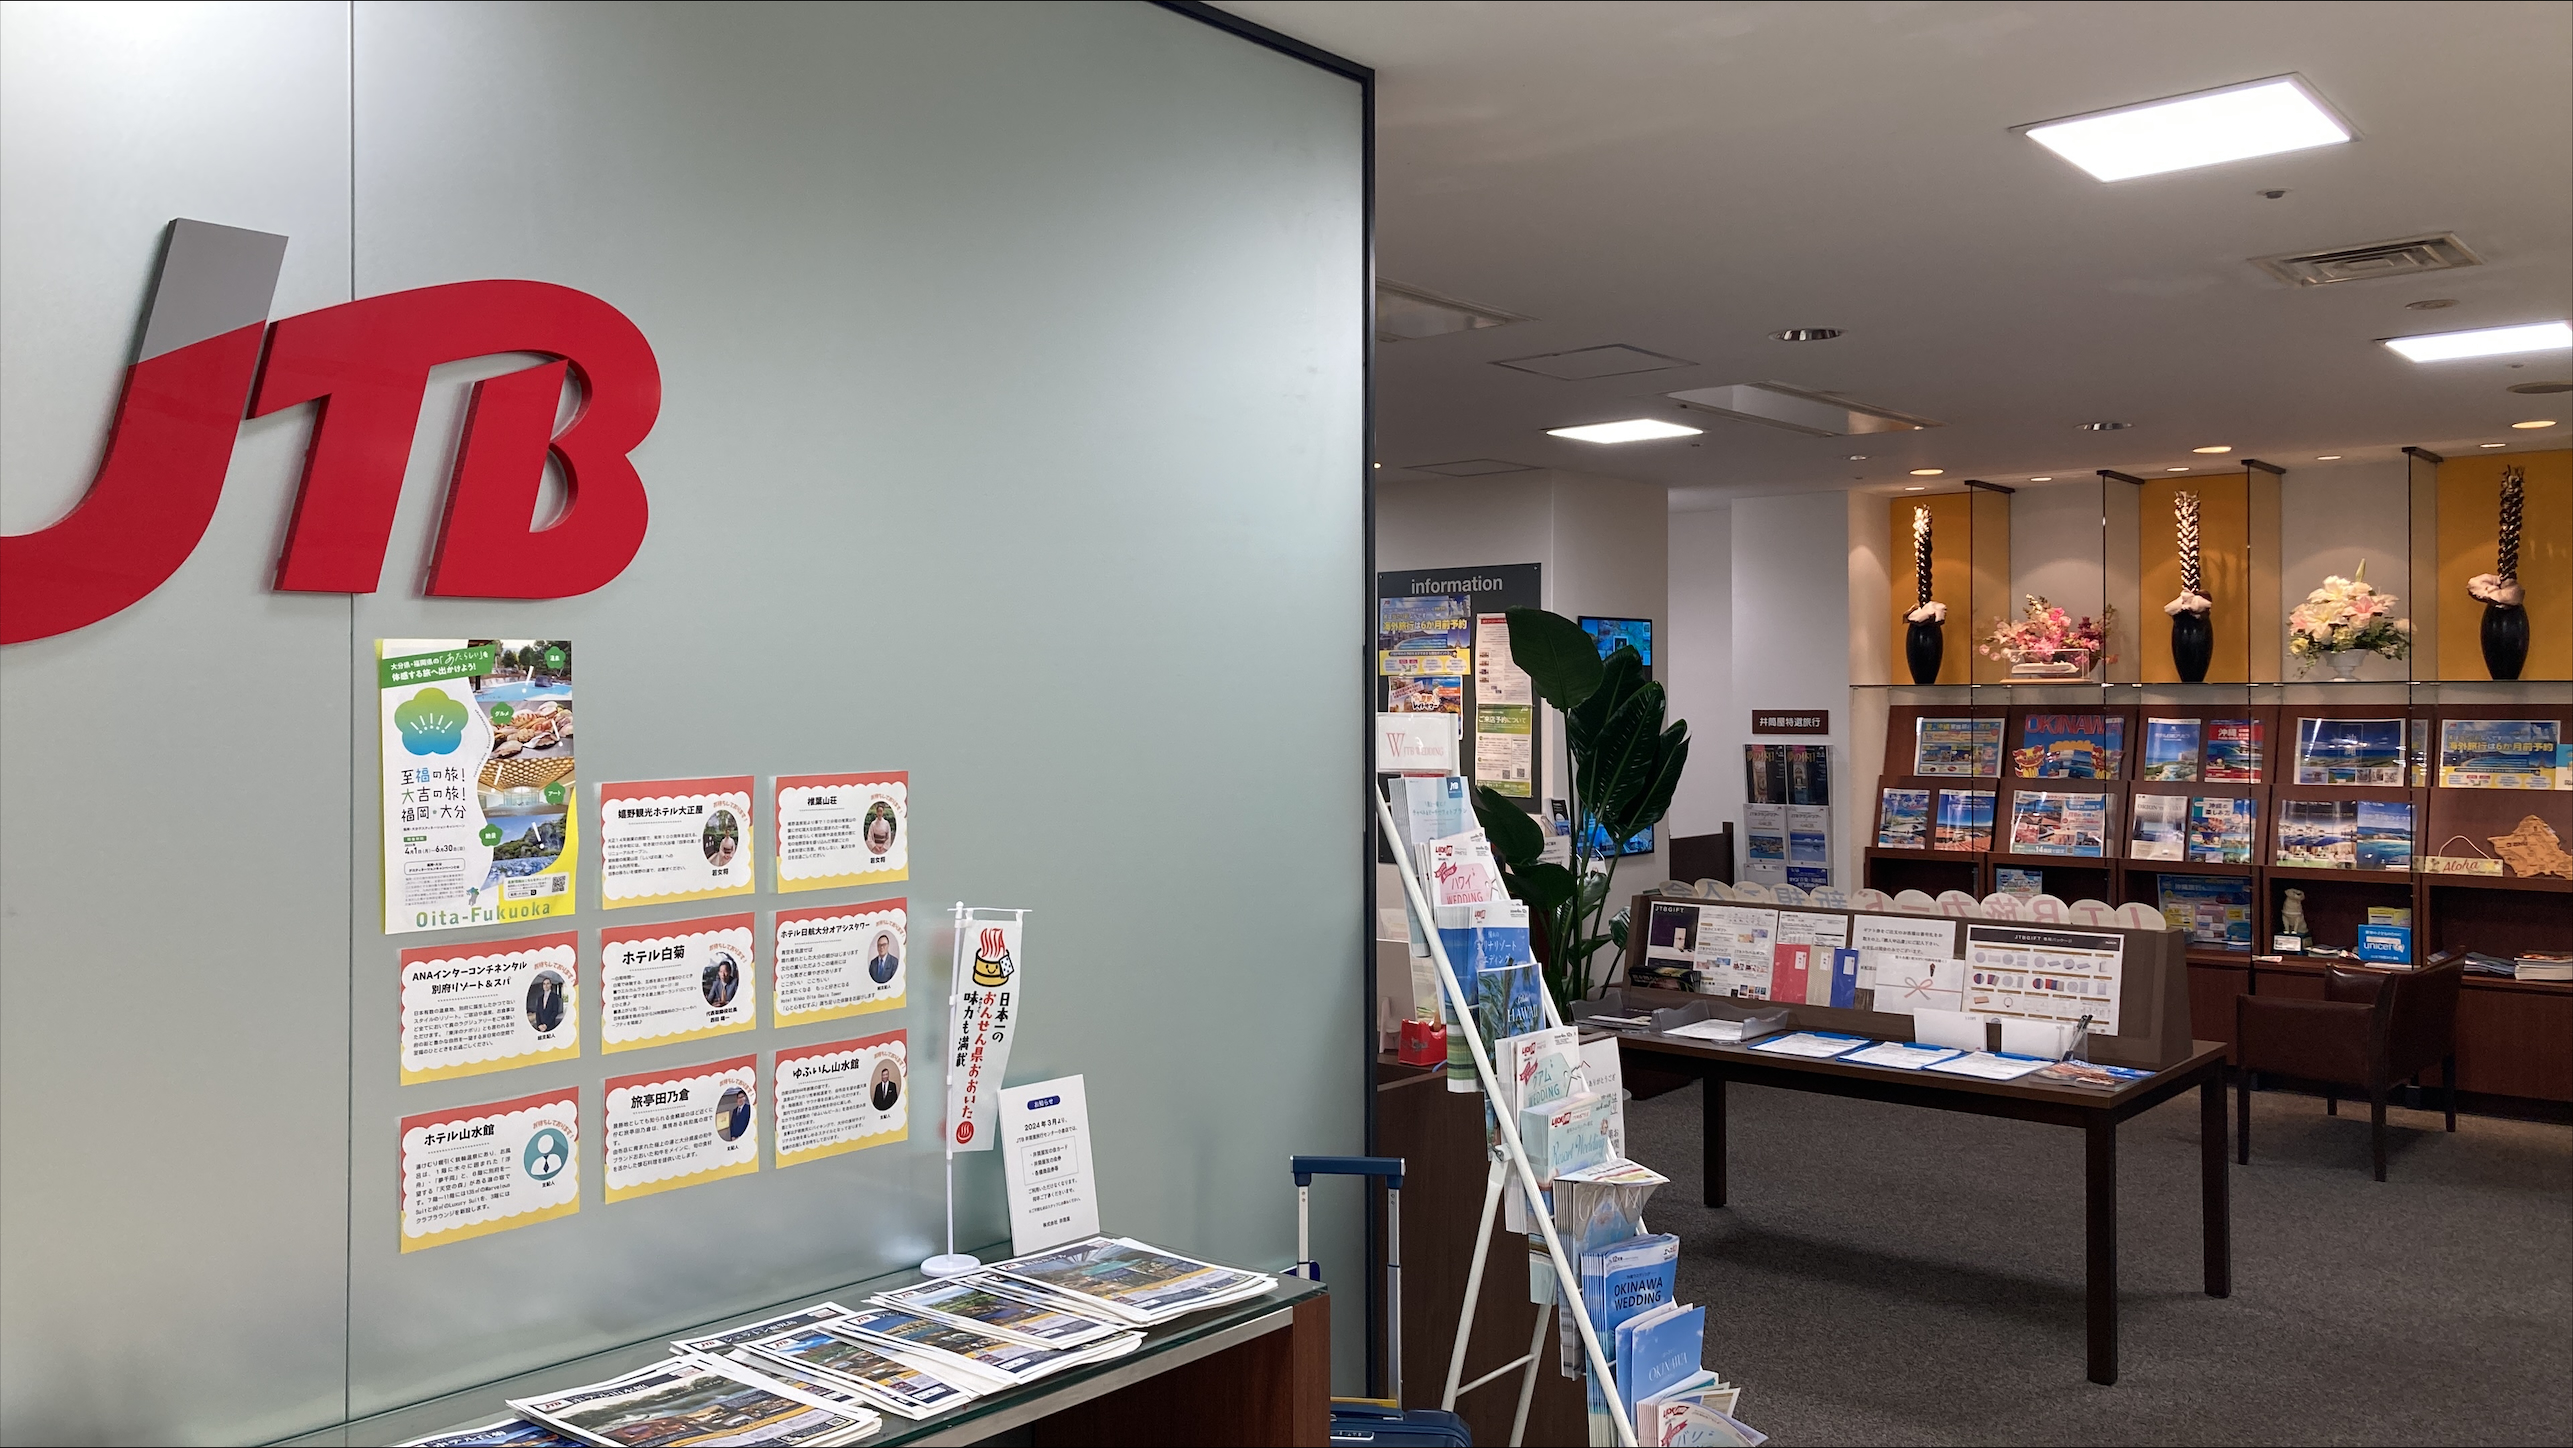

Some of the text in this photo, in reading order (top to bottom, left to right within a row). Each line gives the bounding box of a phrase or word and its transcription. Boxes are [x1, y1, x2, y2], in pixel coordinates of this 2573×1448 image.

[0, 218, 661, 645] JTB
[1411, 575, 1503, 595] information
[1383, 619, 1468, 632] 海外旅行は6か月前予約
[495, 710, 509, 718] グルメ
[1478, 716, 1527, 724] ご来店予約について
[1759, 717, 1821, 727] 井筒屋特選旅行
[2025, 714, 2122, 735] OKINAWA
[1386, 732, 1405, 757] W
[2449, 742, 2554, 752] 海外旅行は6か月前予約
[401, 767, 465, 785] 至福の旅！
[401, 786, 465, 804] 大吉の旅！
[401, 804, 466, 822] 福岡・大分
[618, 805, 703, 819] 嬉野観光ホテル大正屋
[2442, 859, 2479, 872] Aloha
[1452, 875, 1472, 890] ハワイ
[1446, 892, 1484, 905] WEDDING
[416, 902, 551, 928] Oita-Fukuoka
[1655, 905, 1685, 914] JTBGIFT
[781, 922, 870, 938] ホテル日航大分オアシスタワー
[2014, 934, 2042, 942] JTBGIFT
[980, 927, 1006, 958] OITA
[2363, 942, 2394, 951] unicef
[622, 945, 685, 965] ホテル白菊
[412, 961, 528, 982] ANAインターコンチネンタル
[992, 992, 1010, 1043] 日本一の
[1507, 1004, 1538, 1022] HAWAII
[956, 991, 979, 1067] 味力も満載
[962, 991, 997, 1119] おんせん県おおいた
[793, 1058, 859, 1079] ゆふいん山水館
[631, 1088, 690, 1109] 旅亭田乃倉
[1034, 1098, 1054, 1108] お知らせ
[424, 1124, 495, 1146] ホテル山水館
[1614, 1277, 1663, 1297] OKINAWA
[1615, 1291, 1661, 1311] WEDDING
[1648, 1352, 1688, 1381] OKINAWA
